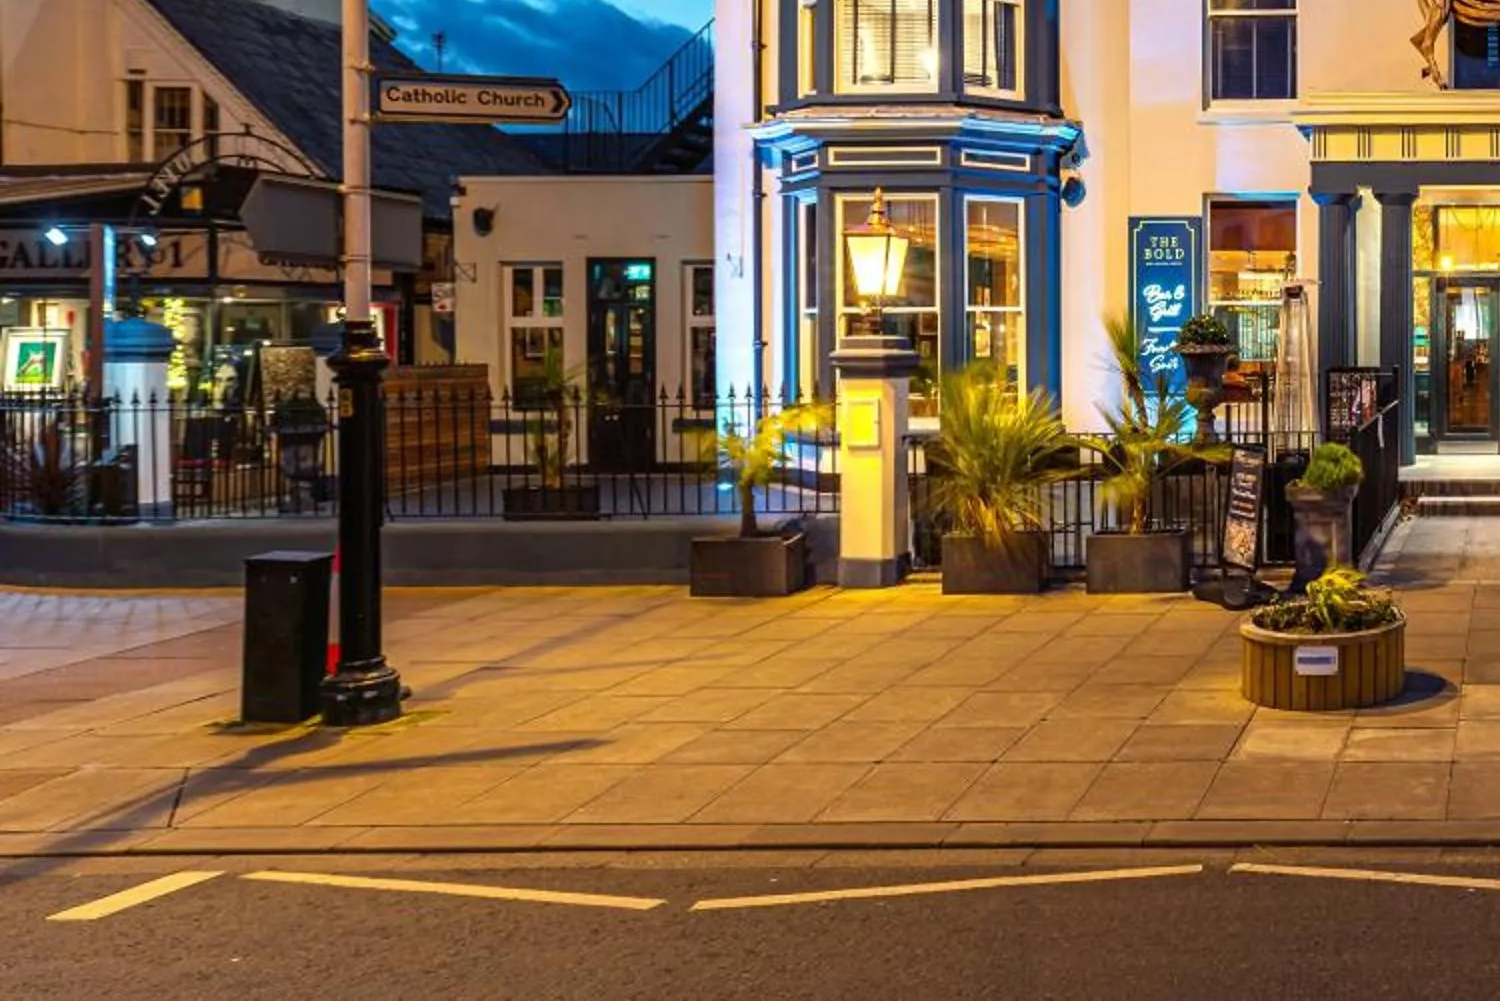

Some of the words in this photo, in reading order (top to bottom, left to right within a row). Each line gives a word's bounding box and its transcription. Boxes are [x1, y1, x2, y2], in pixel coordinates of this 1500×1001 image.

[385, 85, 468, 105] Catholic
[477, 89, 546, 108] Church
[1150, 236, 1179, 248] THE
[1143, 248, 1185, 260] BOLD
